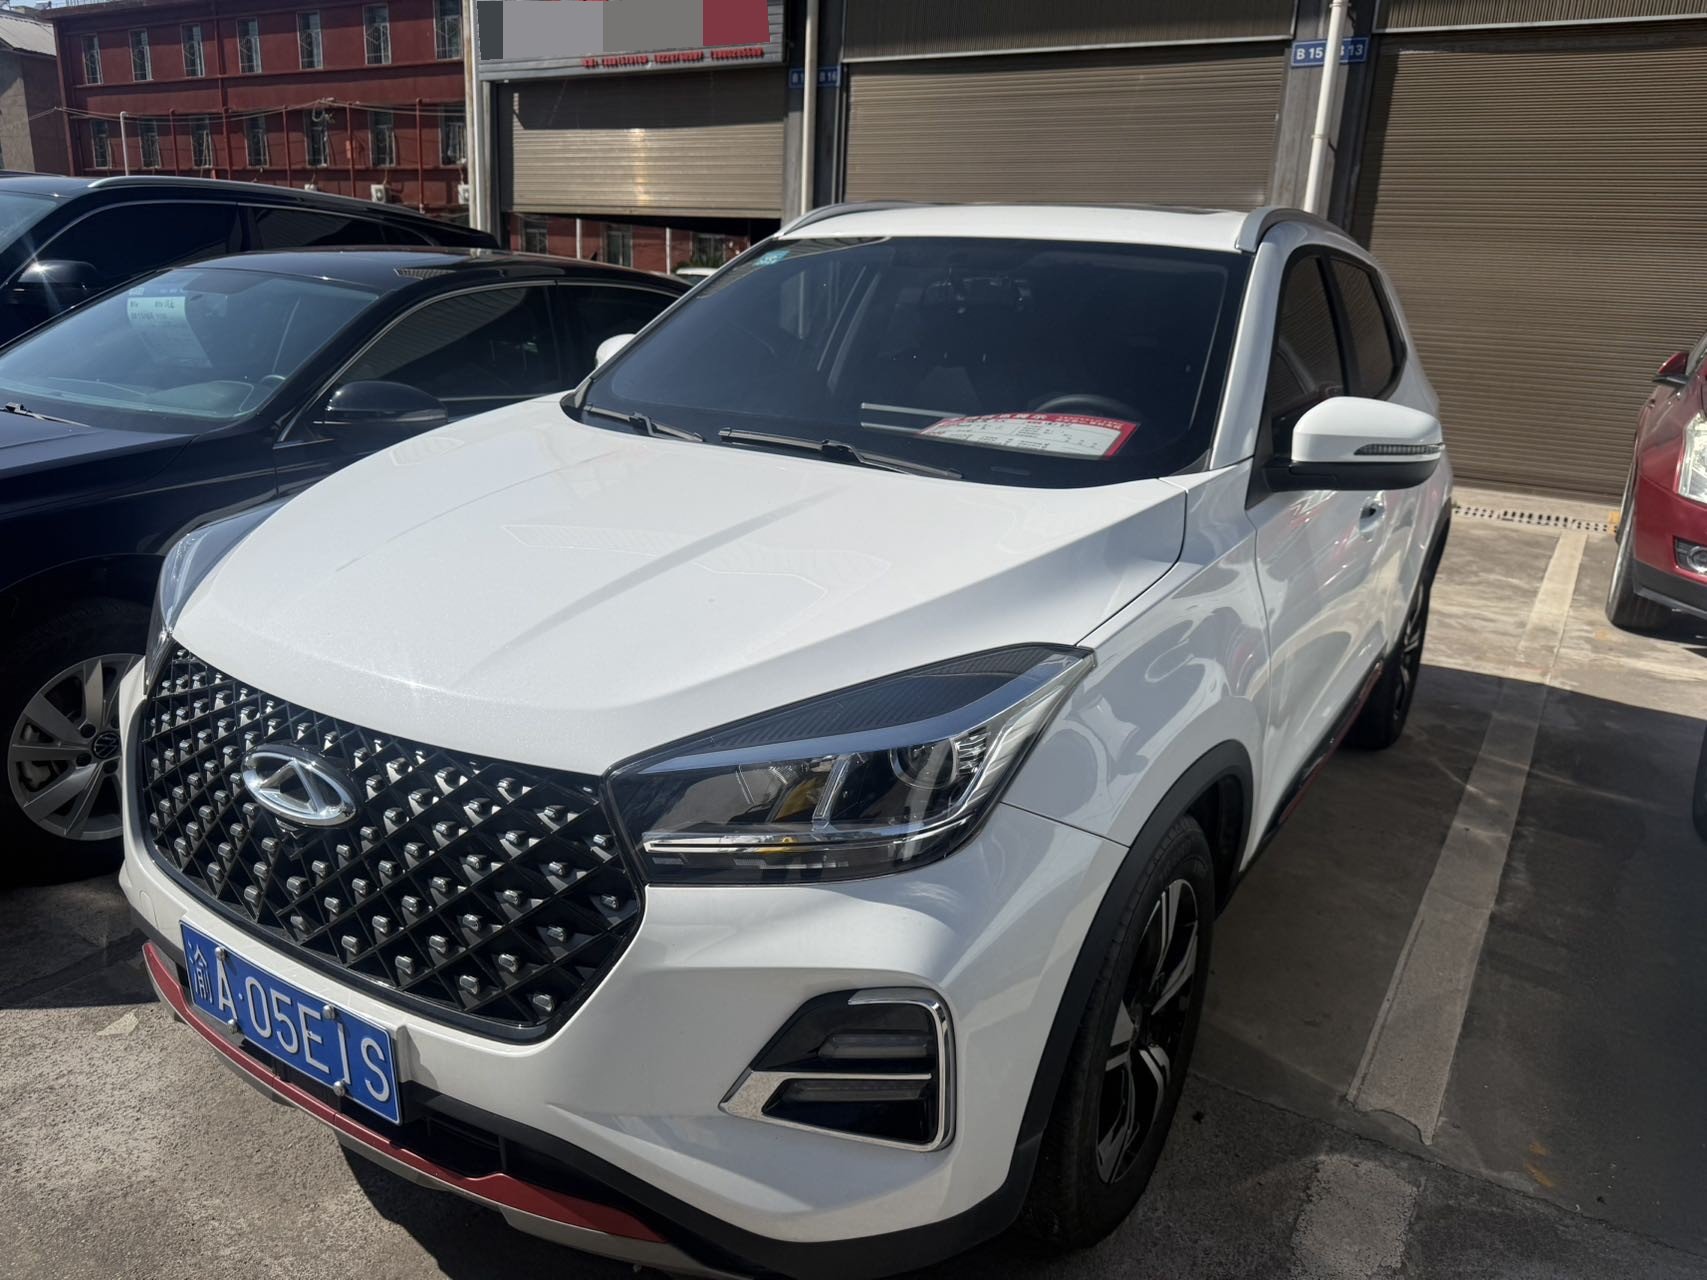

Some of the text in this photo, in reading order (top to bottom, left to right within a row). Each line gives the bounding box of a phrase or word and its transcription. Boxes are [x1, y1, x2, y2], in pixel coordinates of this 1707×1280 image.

[1296, 47, 1306, 60] B
[1308, 46, 1324, 59] 15
[1347, 44, 1364, 56] 13
